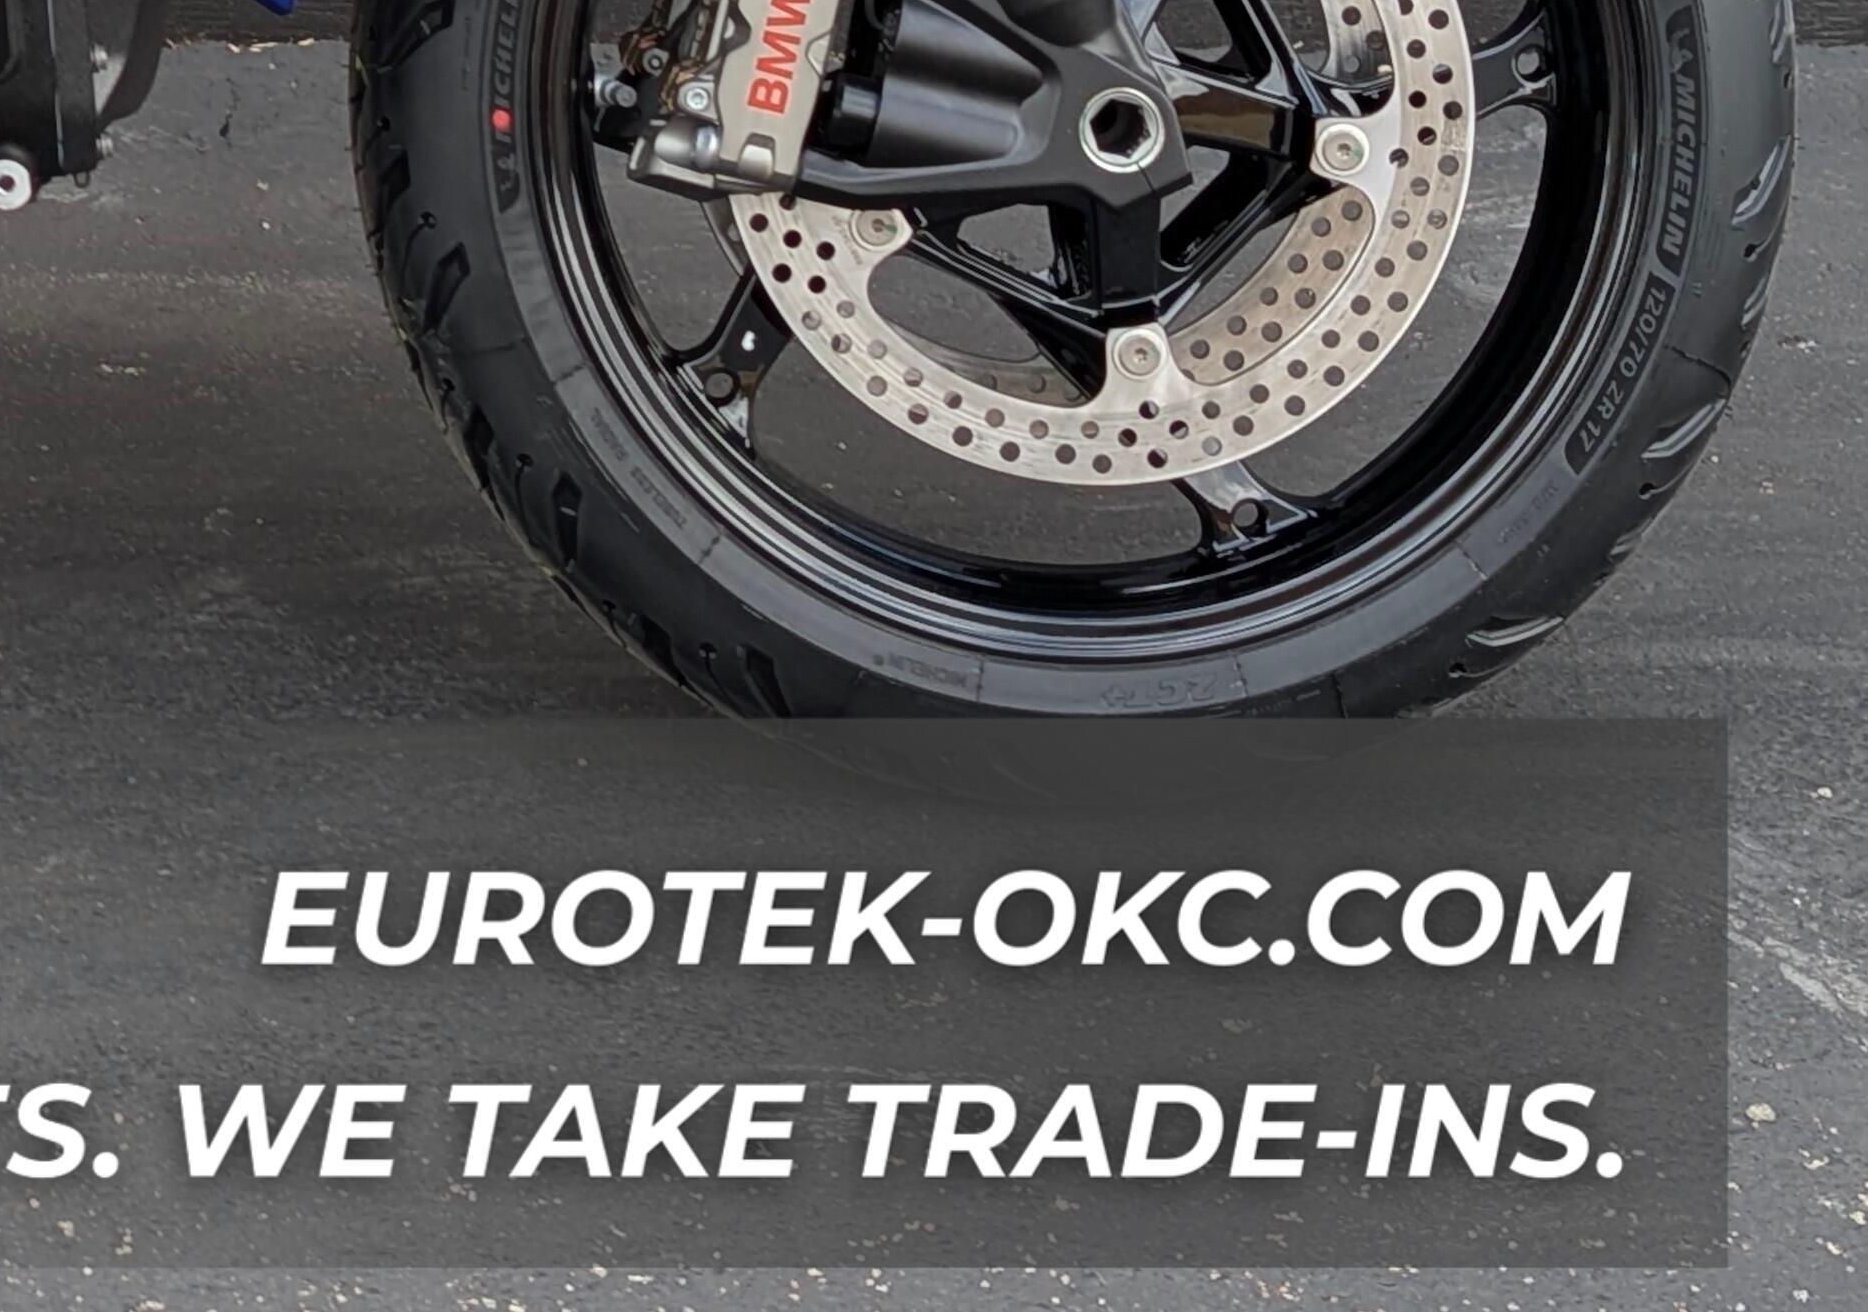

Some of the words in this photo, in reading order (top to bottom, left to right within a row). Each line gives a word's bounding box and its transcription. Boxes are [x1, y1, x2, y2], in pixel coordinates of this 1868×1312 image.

[1662, 74, 1698, 258] MICHELIN
[1619, 285, 1668, 379] 120/70
[1596, 384, 1625, 422] ZR
[1579, 426, 1602, 453] 17
